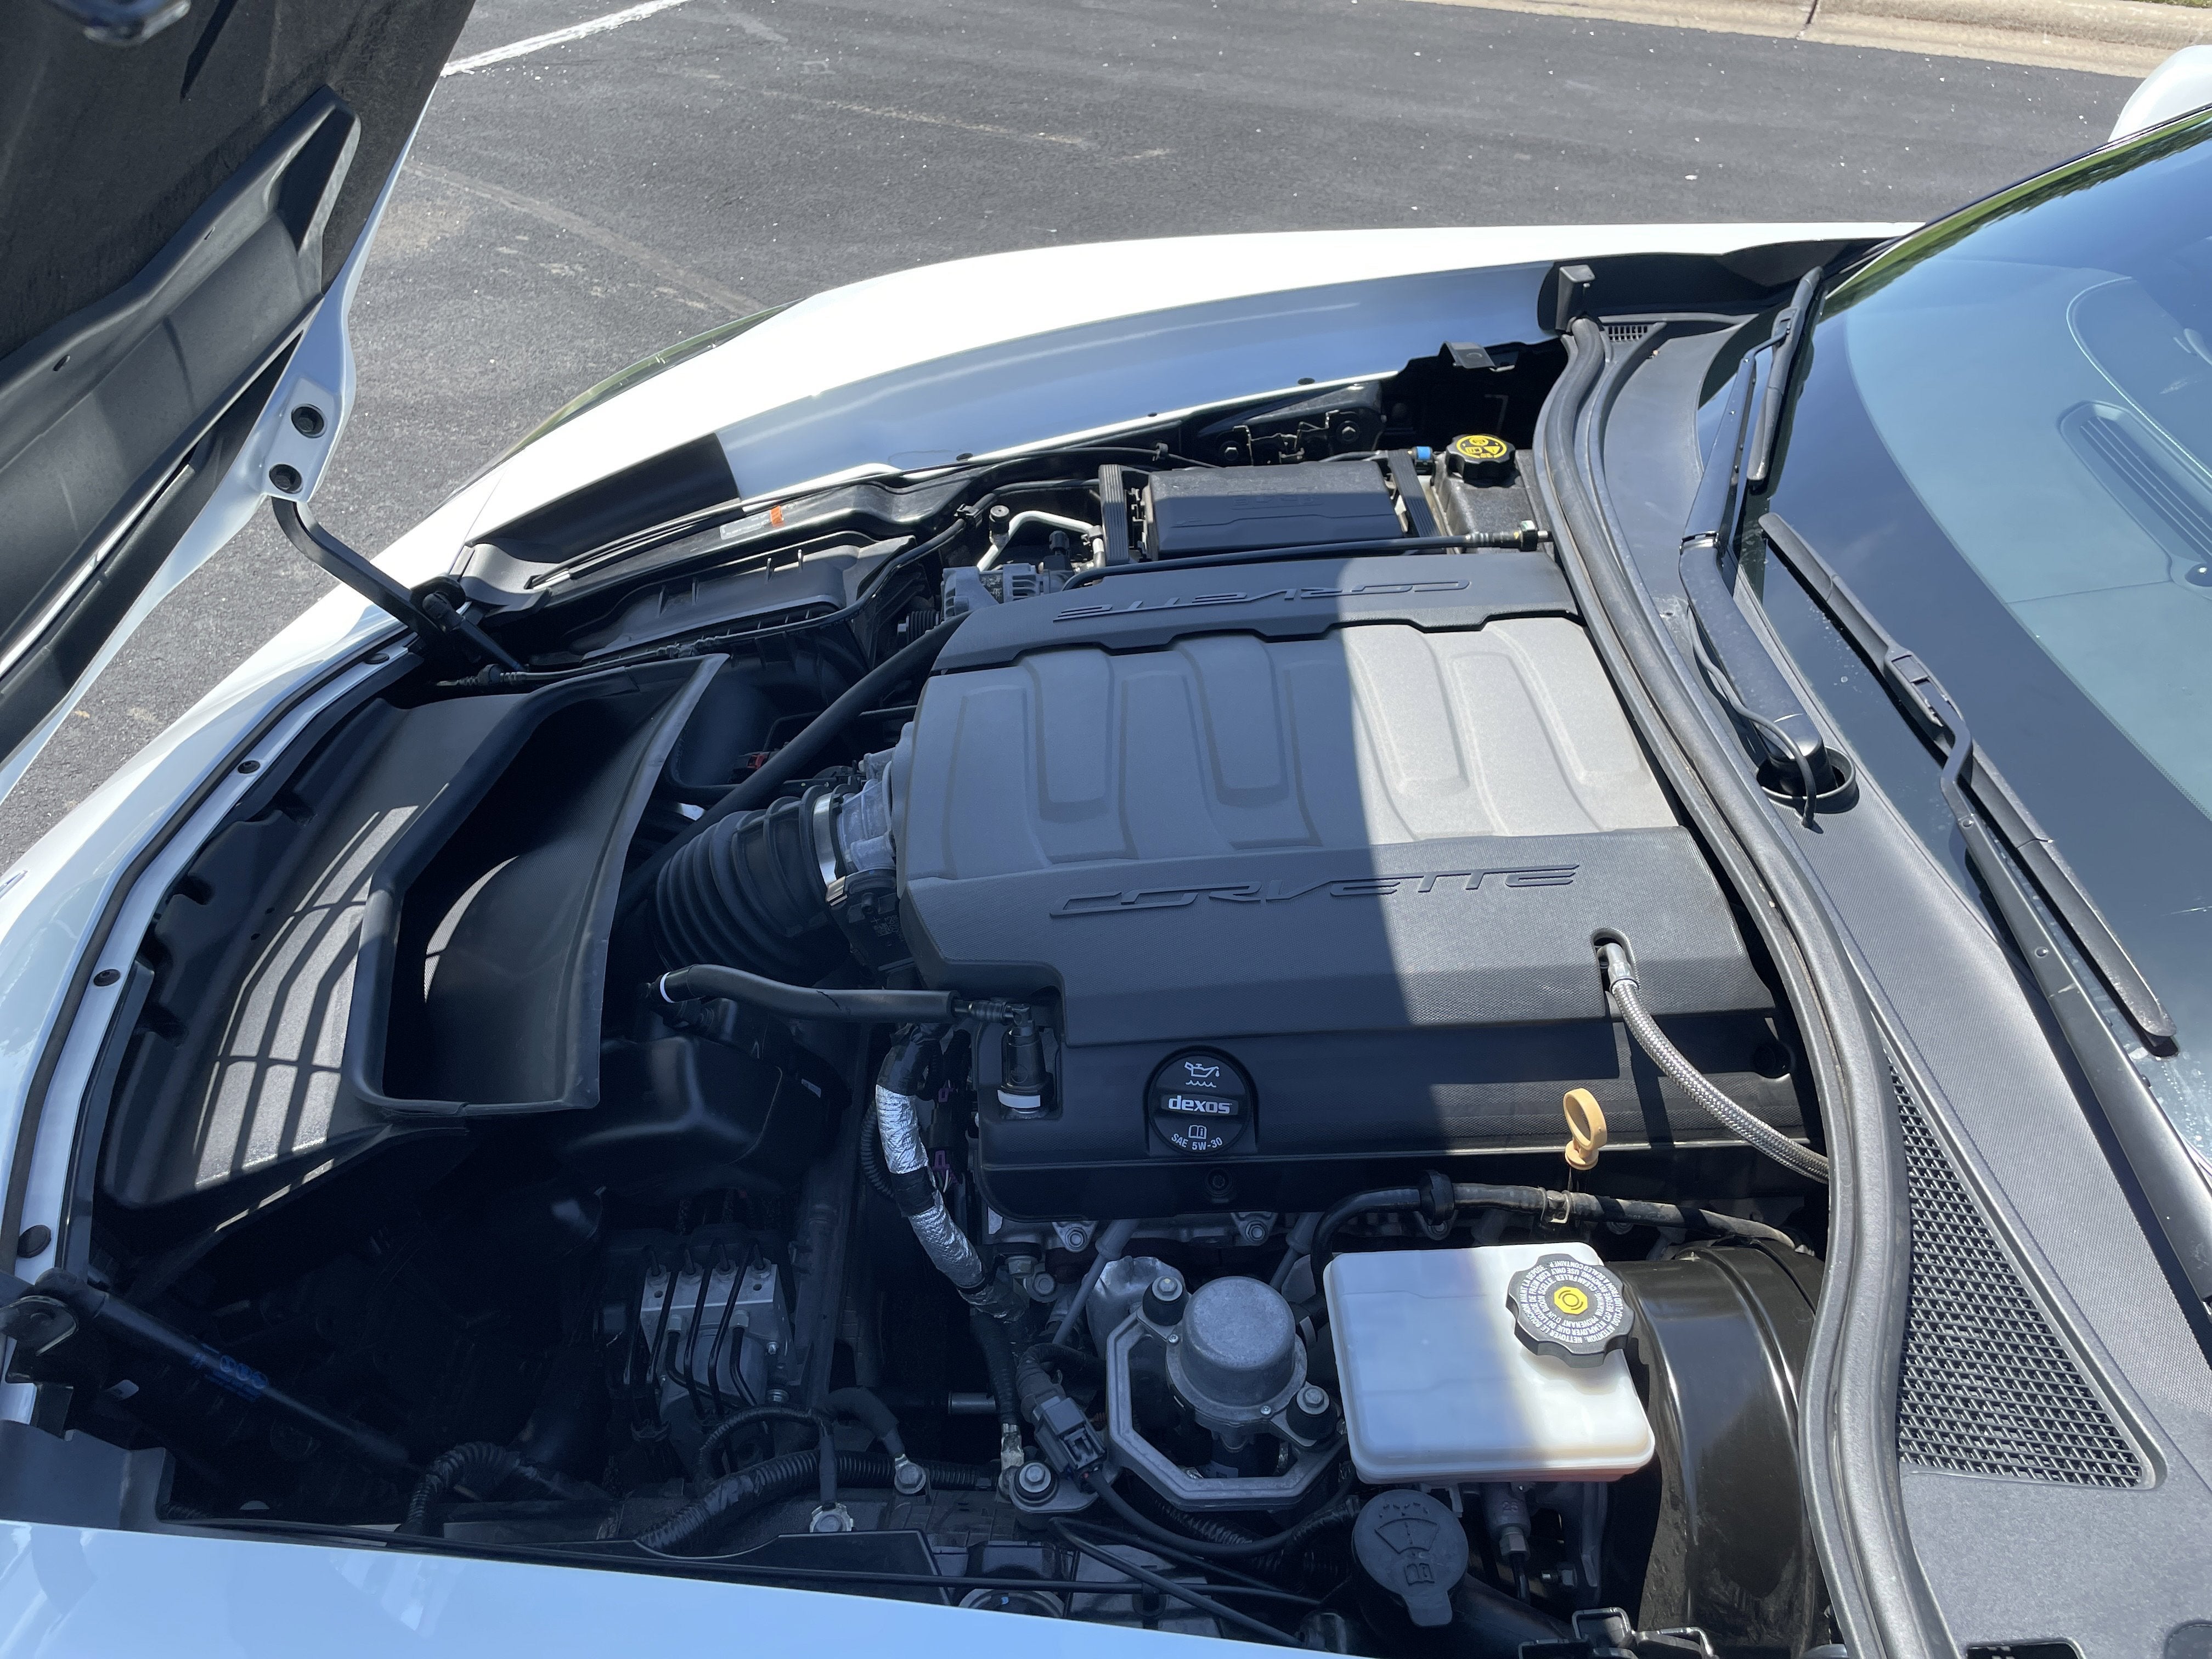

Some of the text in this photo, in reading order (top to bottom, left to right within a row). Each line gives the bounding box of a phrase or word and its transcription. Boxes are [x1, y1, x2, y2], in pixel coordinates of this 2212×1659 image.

[1053, 579, 1471, 622] CORVETTE
[1049, 863, 1580, 917] CORVETTE
[1169, 1096, 1231, 1114] dexos
[1171, 1133, 1223, 1150] SAE 5W-30
[1583, 1263, 1606, 1280] SEALED
[1528, 1279, 1541, 1295] FREIN
[1577, 1277, 1597, 1291] CLEAN
[1605, 1283, 1620, 1297] FROM
[1519, 1286, 1528, 1302] AVANT
[1602, 1292, 1614, 1312] BEFORE
[1537, 1295, 1550, 1312] BIDON
[1594, 1290, 1605, 1317] WARNING:
[1521, 1304, 1543, 1328] BOUCHON
[1530, 1303, 1549, 1323] LIQUIDE
[1546, 1311, 1562, 1323] D'UN
[1602, 1312, 1612, 1322] CAP
[1538, 1324, 1550, 1334] LE
[1544, 1320, 1557, 1329] DU
[1556, 1325, 1571, 1335] QUE
[1561, 1316, 1599, 1328] PROVENANT
[1571, 1321, 1607, 1336] N'EMPLOYER
[1549, 1330, 1583, 1343] NETTOYER
[1584, 1324, 1616, 1342] ATTENTION:
